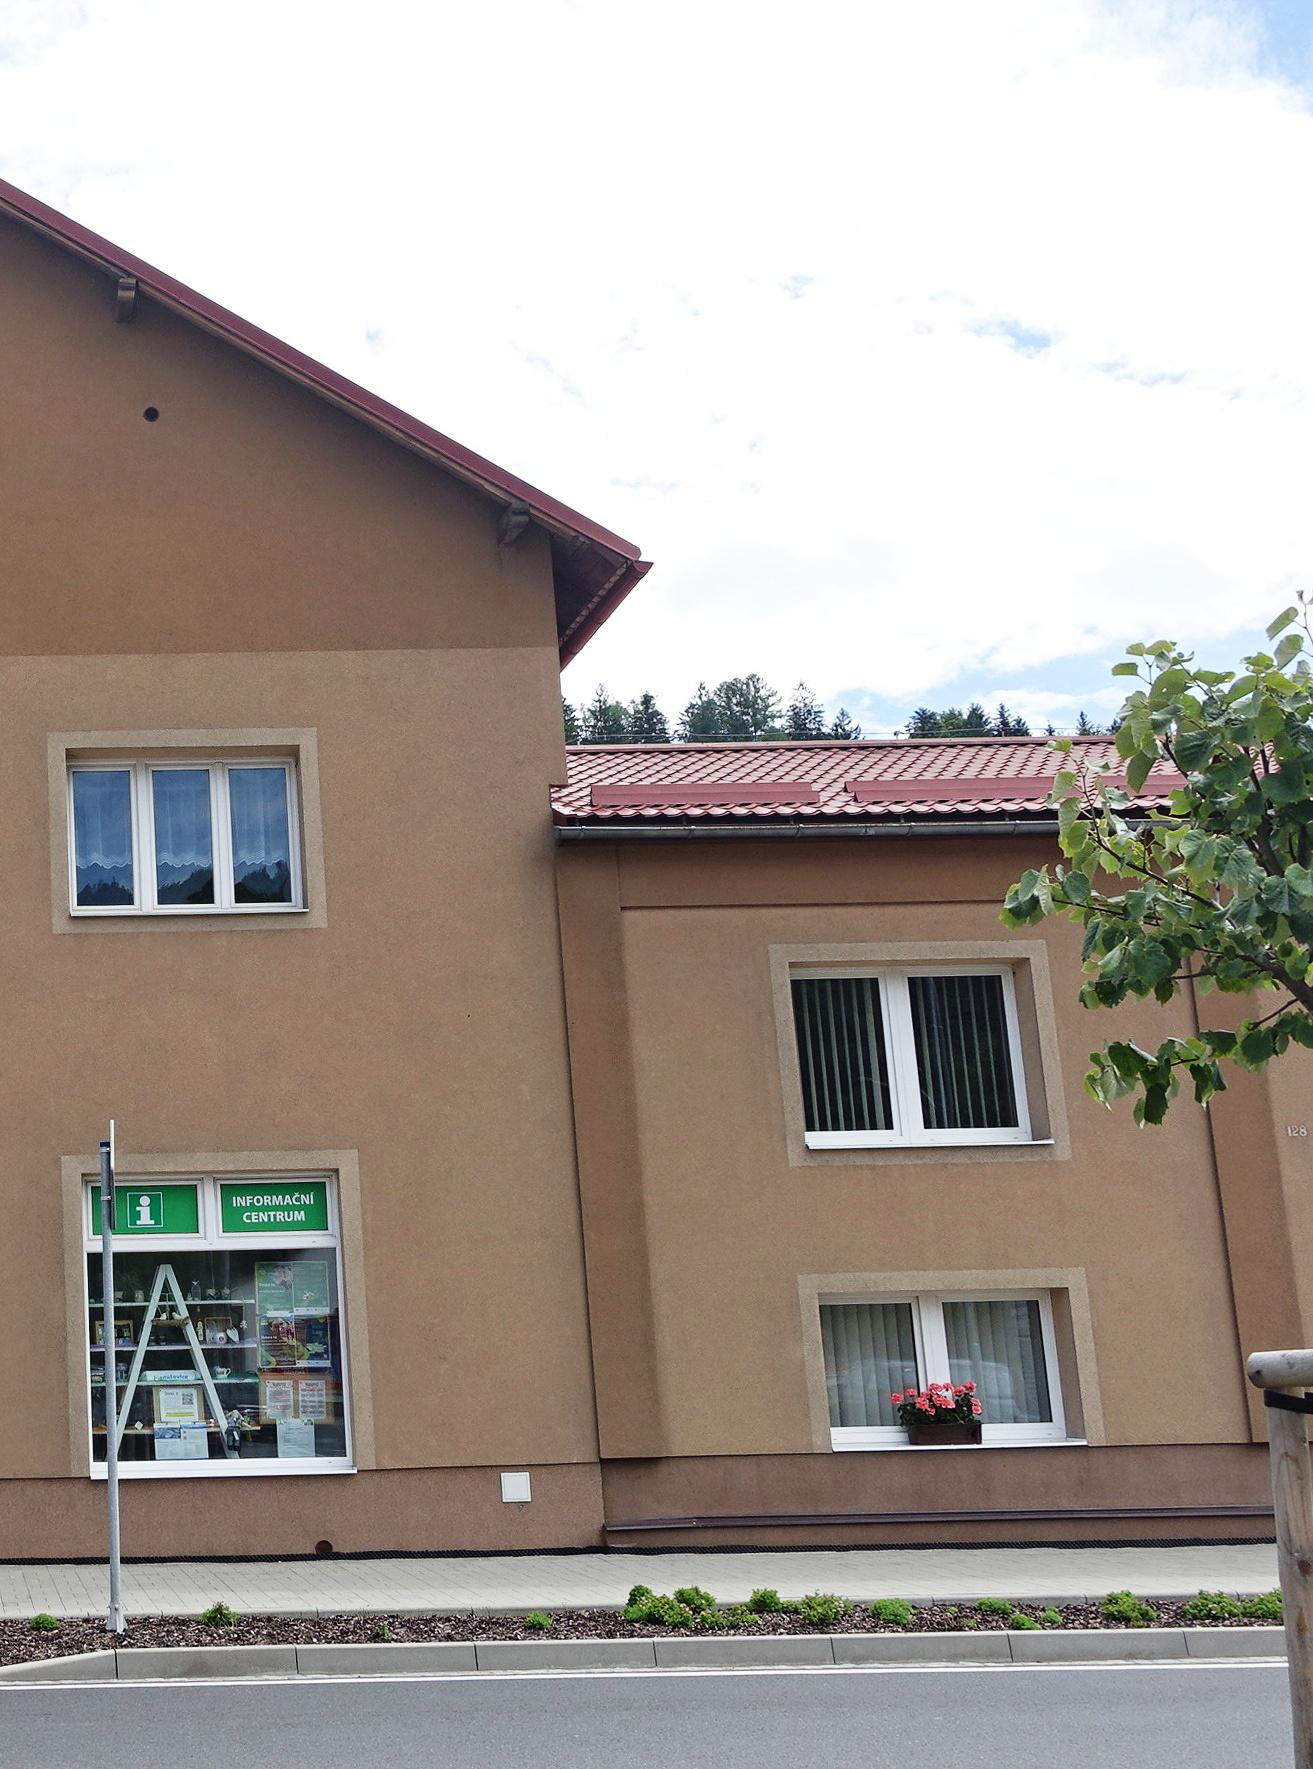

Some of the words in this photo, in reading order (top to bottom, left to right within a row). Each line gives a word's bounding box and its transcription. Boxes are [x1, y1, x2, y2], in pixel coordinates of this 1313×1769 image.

[1287, 1125, 1308, 1137] 128
[232, 1192, 314, 1207] INFORMAČNÍ
[242, 1210, 306, 1223] CENTRUM
